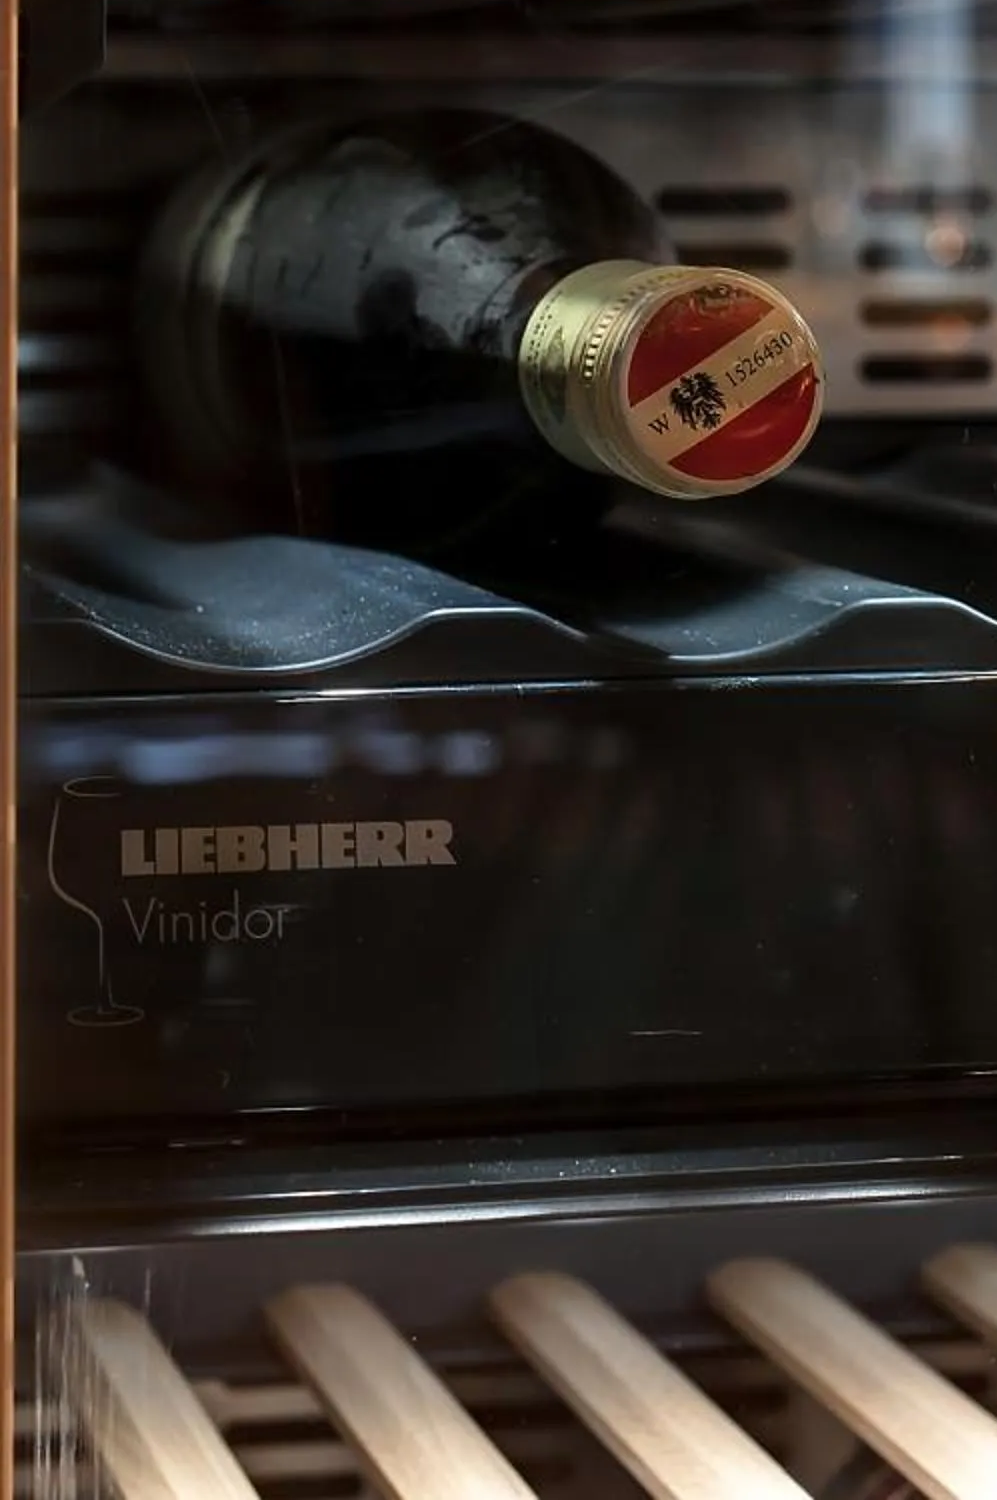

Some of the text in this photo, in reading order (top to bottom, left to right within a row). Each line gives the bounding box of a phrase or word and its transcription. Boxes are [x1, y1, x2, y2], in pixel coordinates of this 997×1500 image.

[648, 331, 793, 437] W 1526430
[121, 819, 457, 877] LIEBHERR
[121, 888, 293, 944] Vinidor
